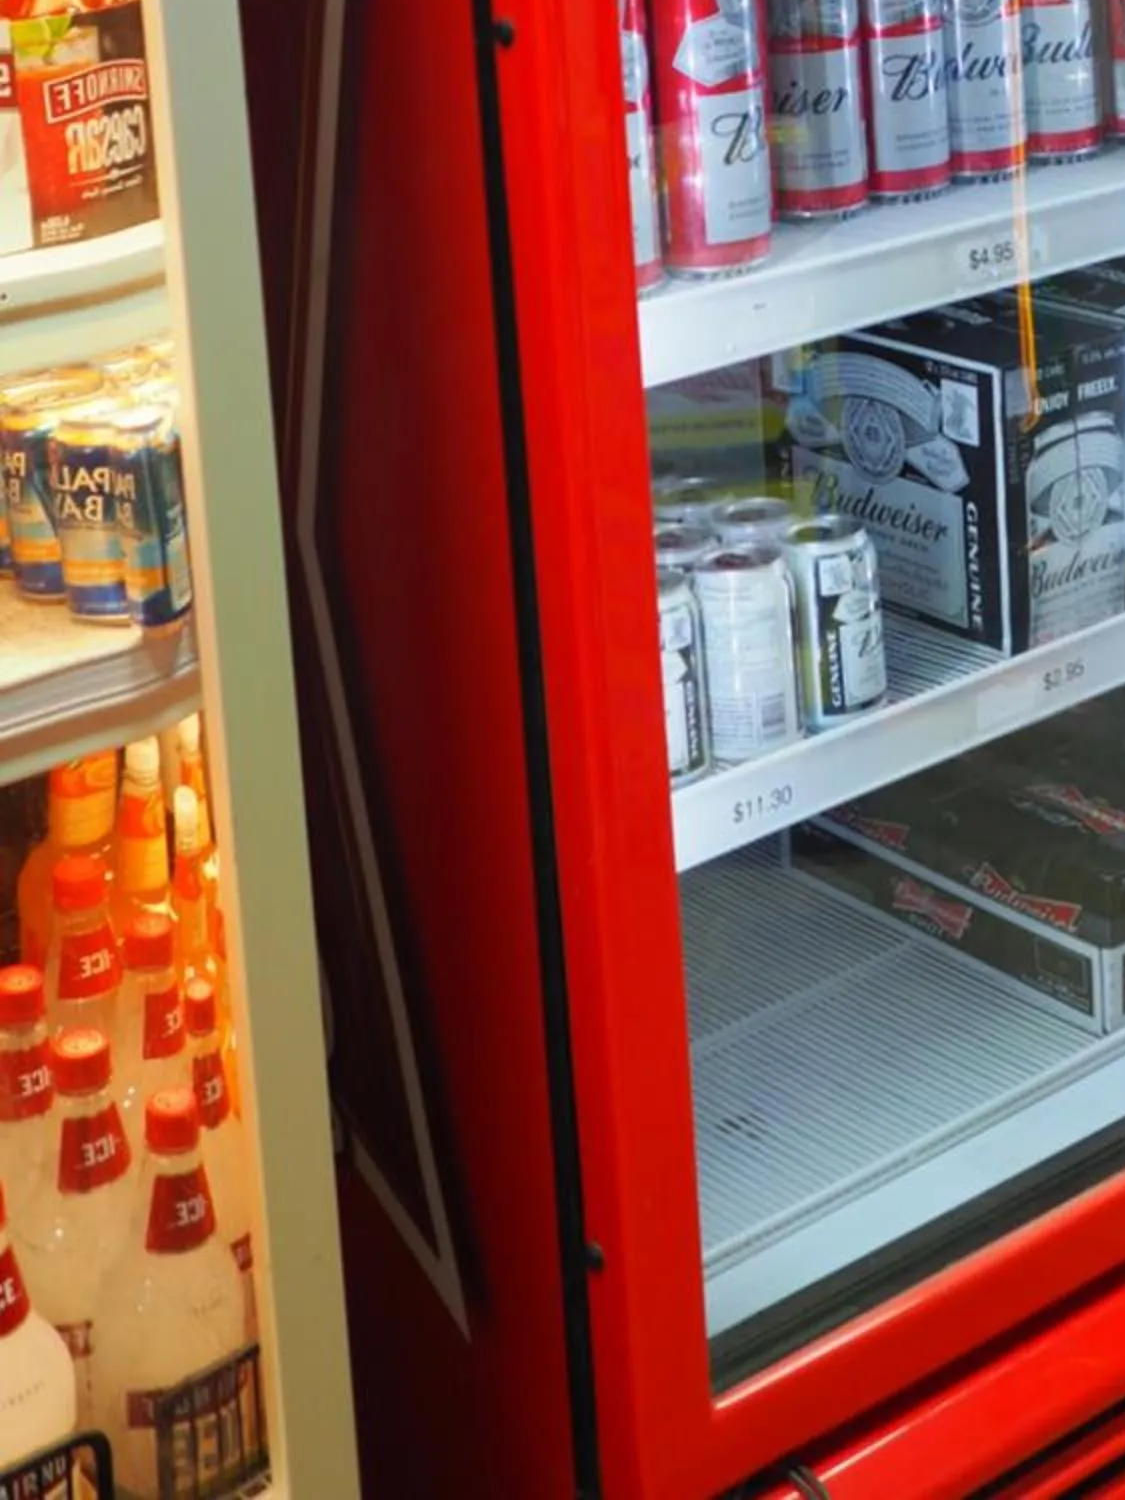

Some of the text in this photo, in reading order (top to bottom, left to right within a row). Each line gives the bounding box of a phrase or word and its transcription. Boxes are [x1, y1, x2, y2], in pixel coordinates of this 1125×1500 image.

[968, 241, 1015, 271] $4.95
[1035, 390, 1070, 415] ENJOY
[812, 468, 950, 544] Budweiser
[965, 500, 985, 633] GENUINE
[732, 784, 794, 824] $11.30
